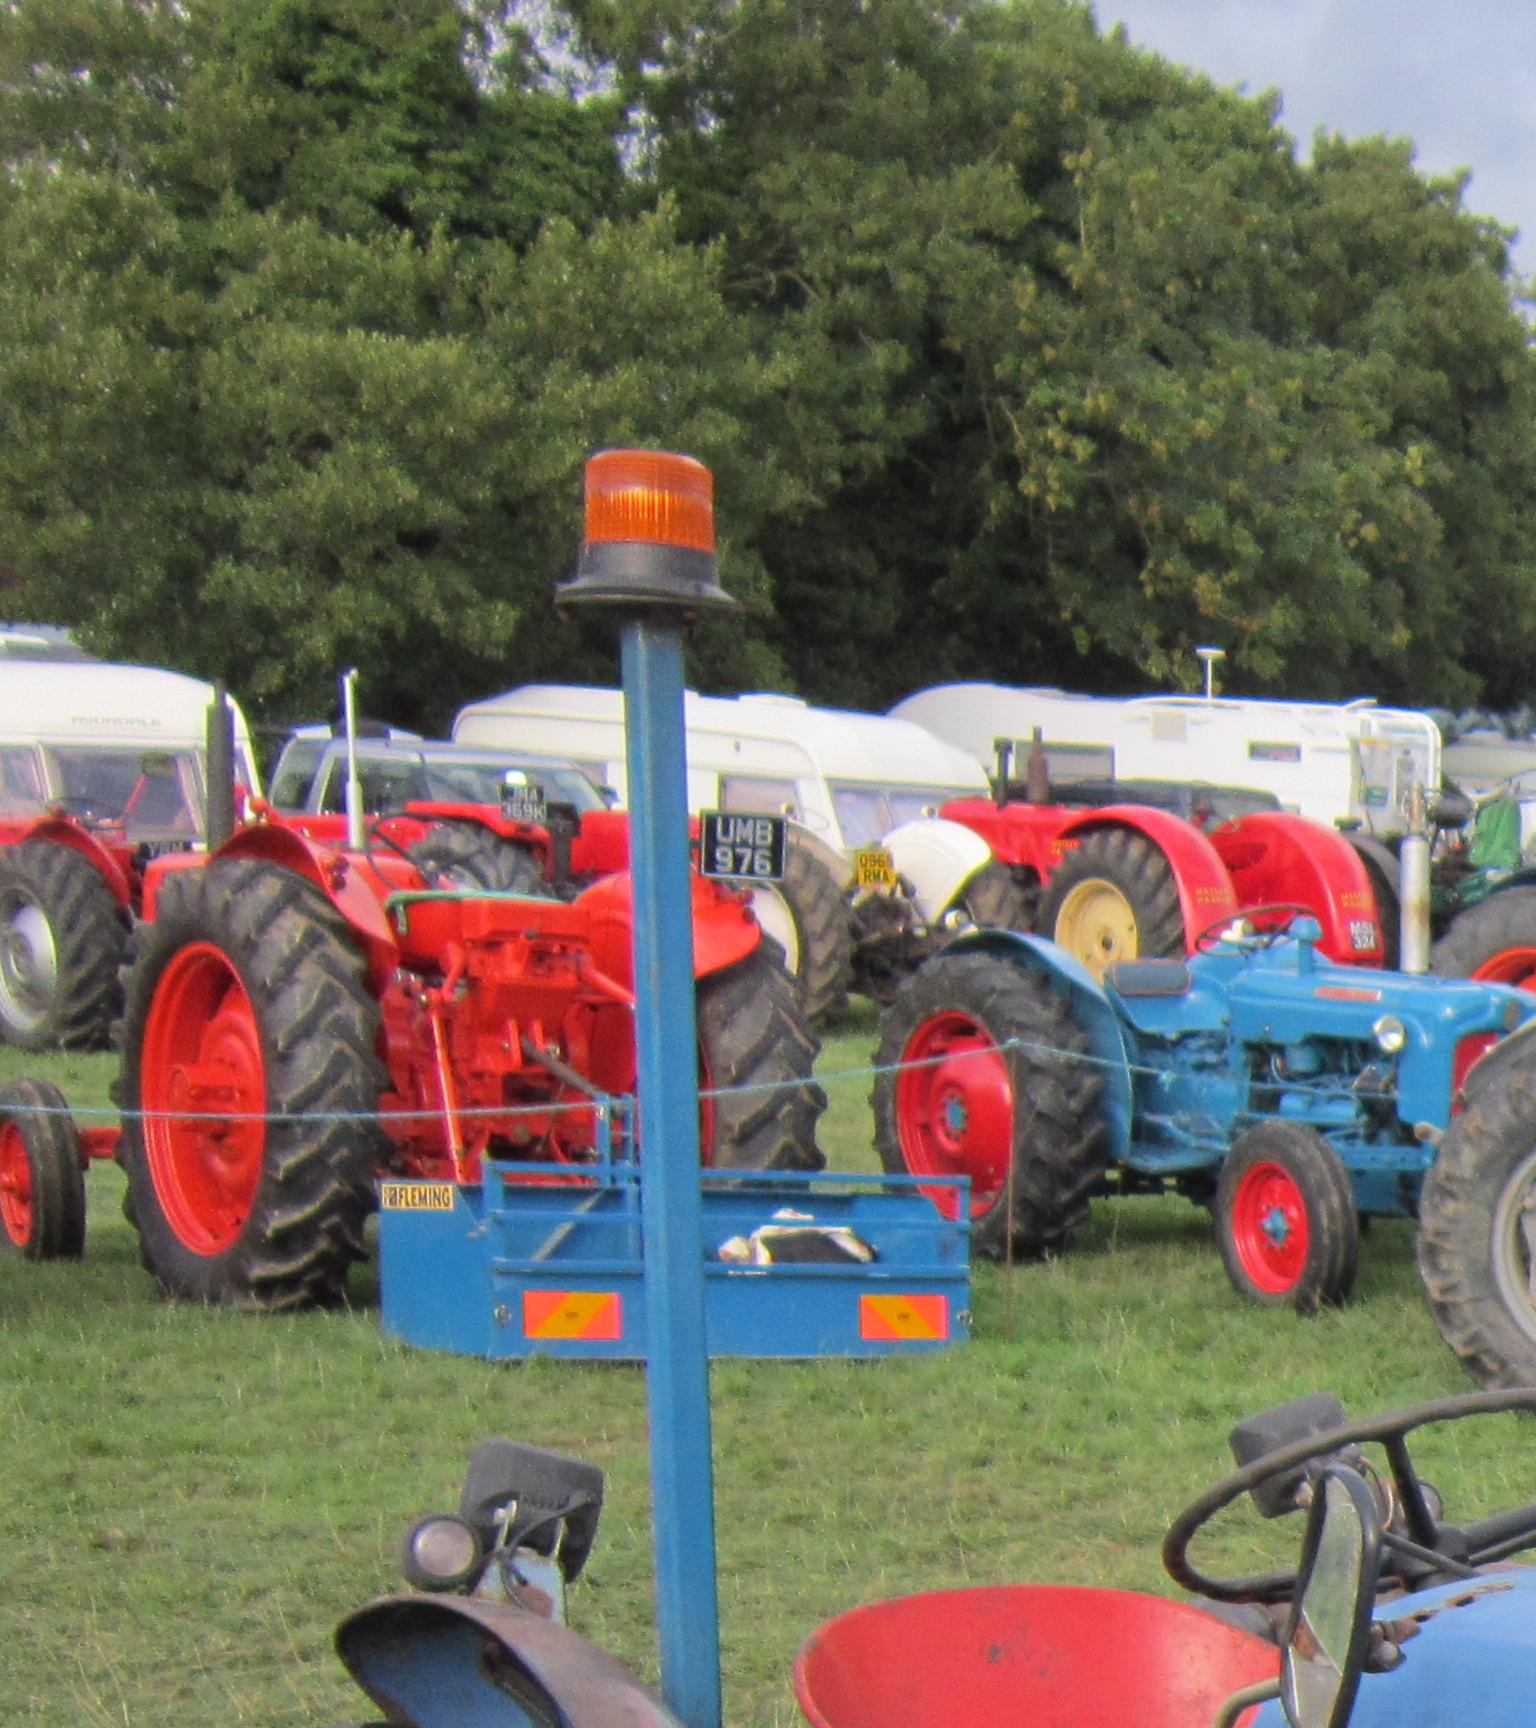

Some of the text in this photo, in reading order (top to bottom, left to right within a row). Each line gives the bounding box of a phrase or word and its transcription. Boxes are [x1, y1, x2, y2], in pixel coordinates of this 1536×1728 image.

[716, 815, 773, 846] UMB
[715, 847, 772, 875] 976
[399, 1186, 450, 1207] FLEMING
